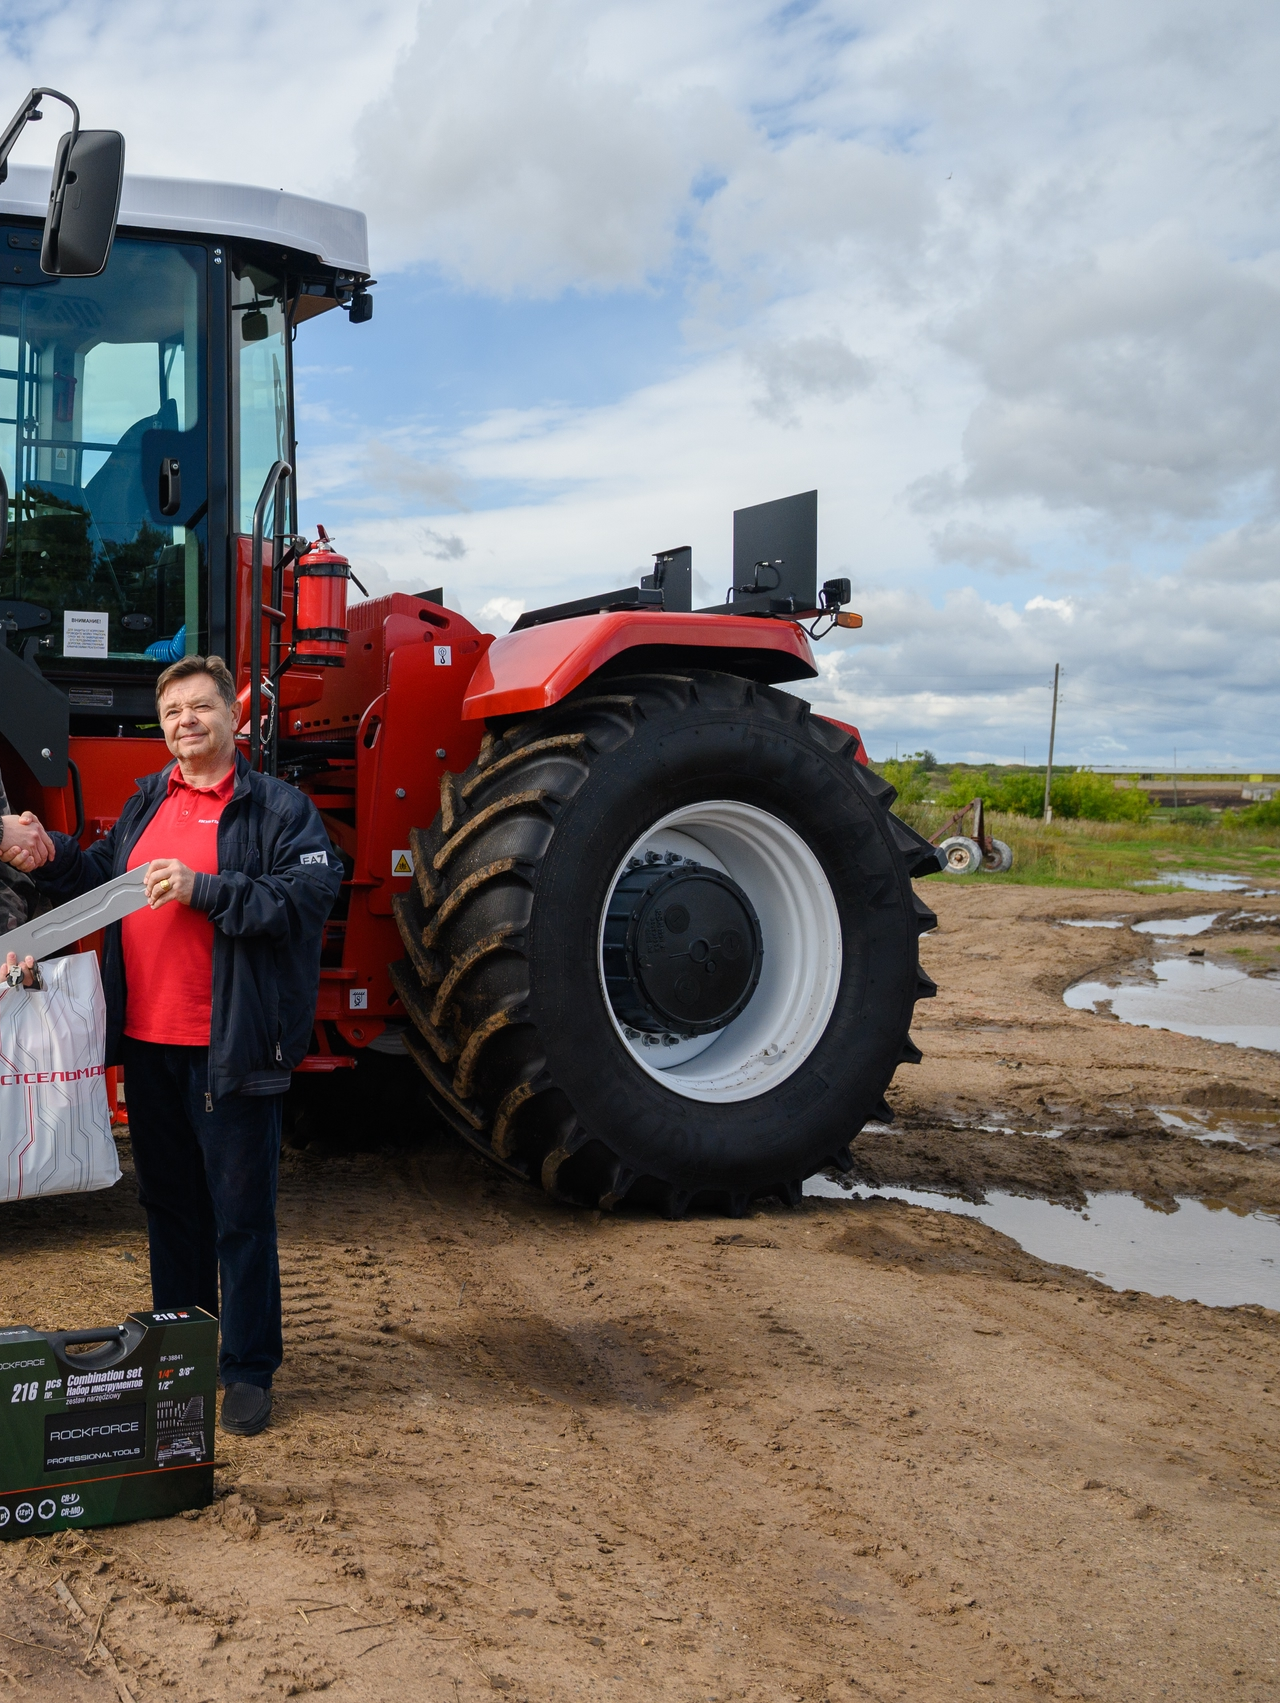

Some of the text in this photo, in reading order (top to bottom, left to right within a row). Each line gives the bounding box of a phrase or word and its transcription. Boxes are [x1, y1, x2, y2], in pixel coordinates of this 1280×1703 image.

[152, 1312, 177, 1321] 216
[10, 1366, 143, 1403] 216 pcs Combination set
[66, 1385, 90, 1397] Набор
[91, 1379, 144, 1393] инструментов
[66, 1397, 86, 1405] zestaw
[50, 1422, 139, 1441] ROCKFORCE
[47, 1447, 140, 1465] PROFESSIONAL TOOLS
[61, 1493, 76, 1503] CR-V
